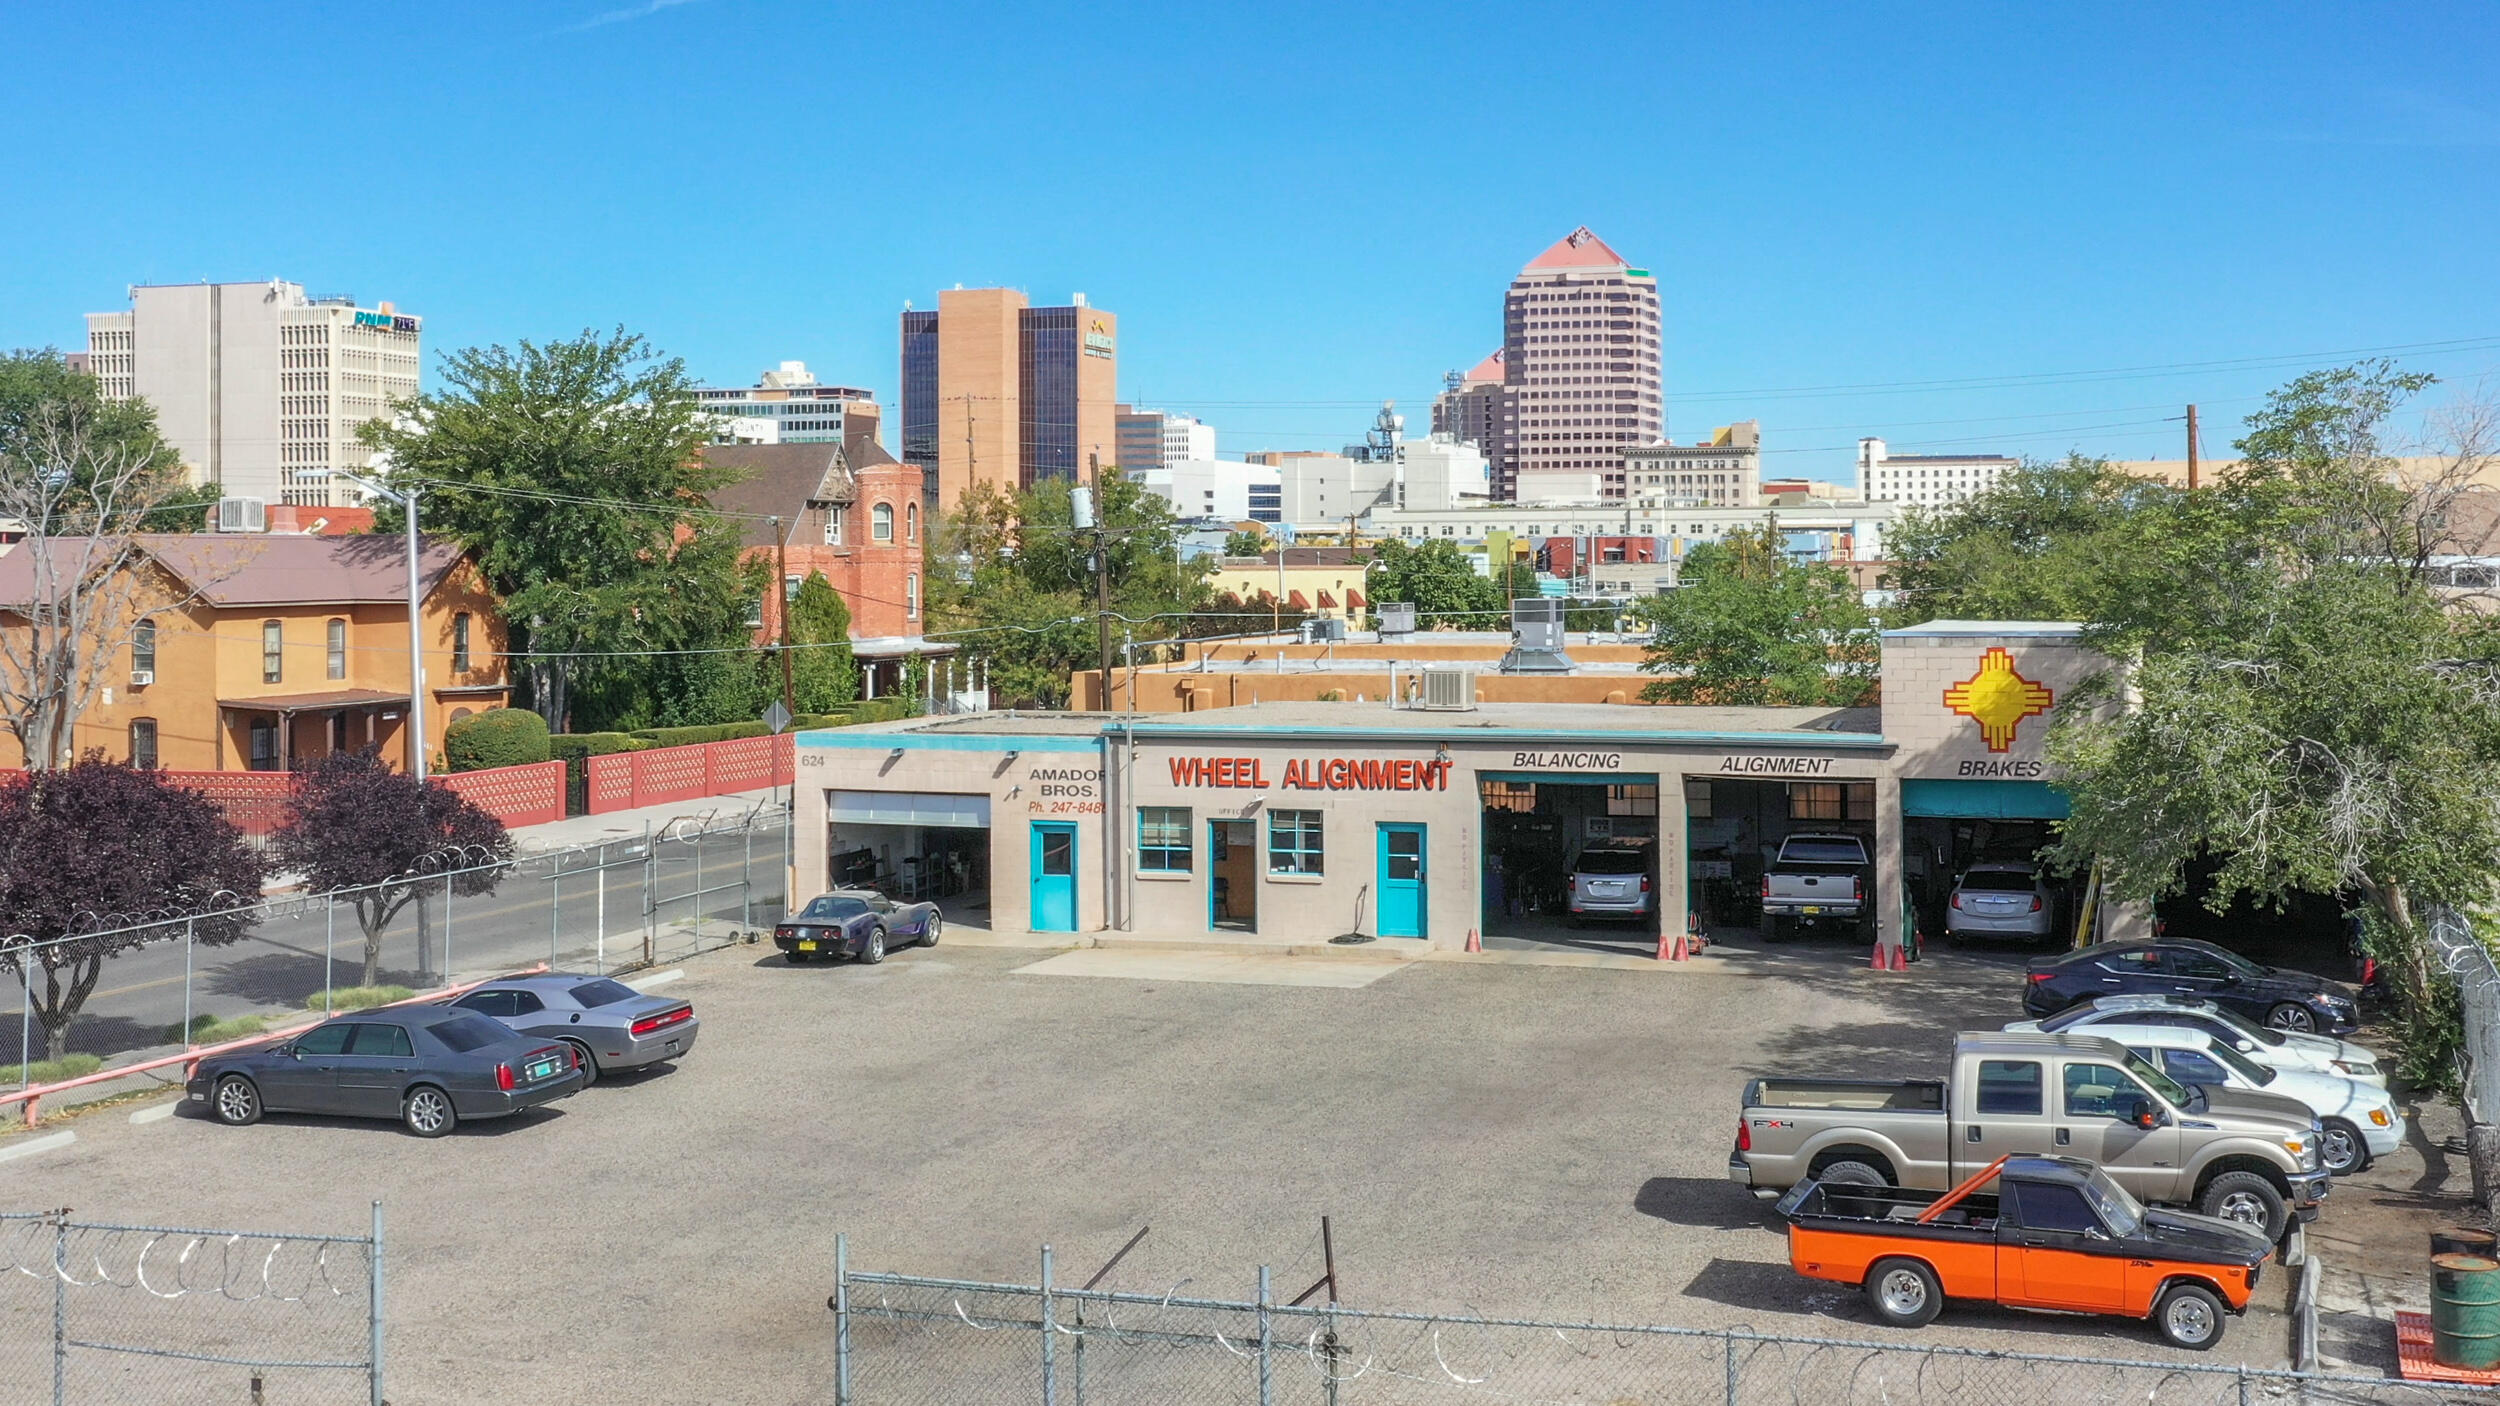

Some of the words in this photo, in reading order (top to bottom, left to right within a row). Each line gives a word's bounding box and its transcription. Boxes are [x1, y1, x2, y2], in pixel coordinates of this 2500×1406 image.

[355, 311, 392, 327] PNM
[801, 755, 824, 766] 624
[1513, 752, 1620, 769] BALANCING
[1720, 757, 1834, 773] ALIGNMENT
[1169, 757, 1270, 788] WHEEL
[1282, 758, 1453, 791] ALIGNMENT
[1958, 761, 2042, 777] BRAKES
[1041, 785, 1098, 797] BROS.
[1028, 801, 1045, 813] Ph.
[1754, 1120, 1793, 1128] FX4
